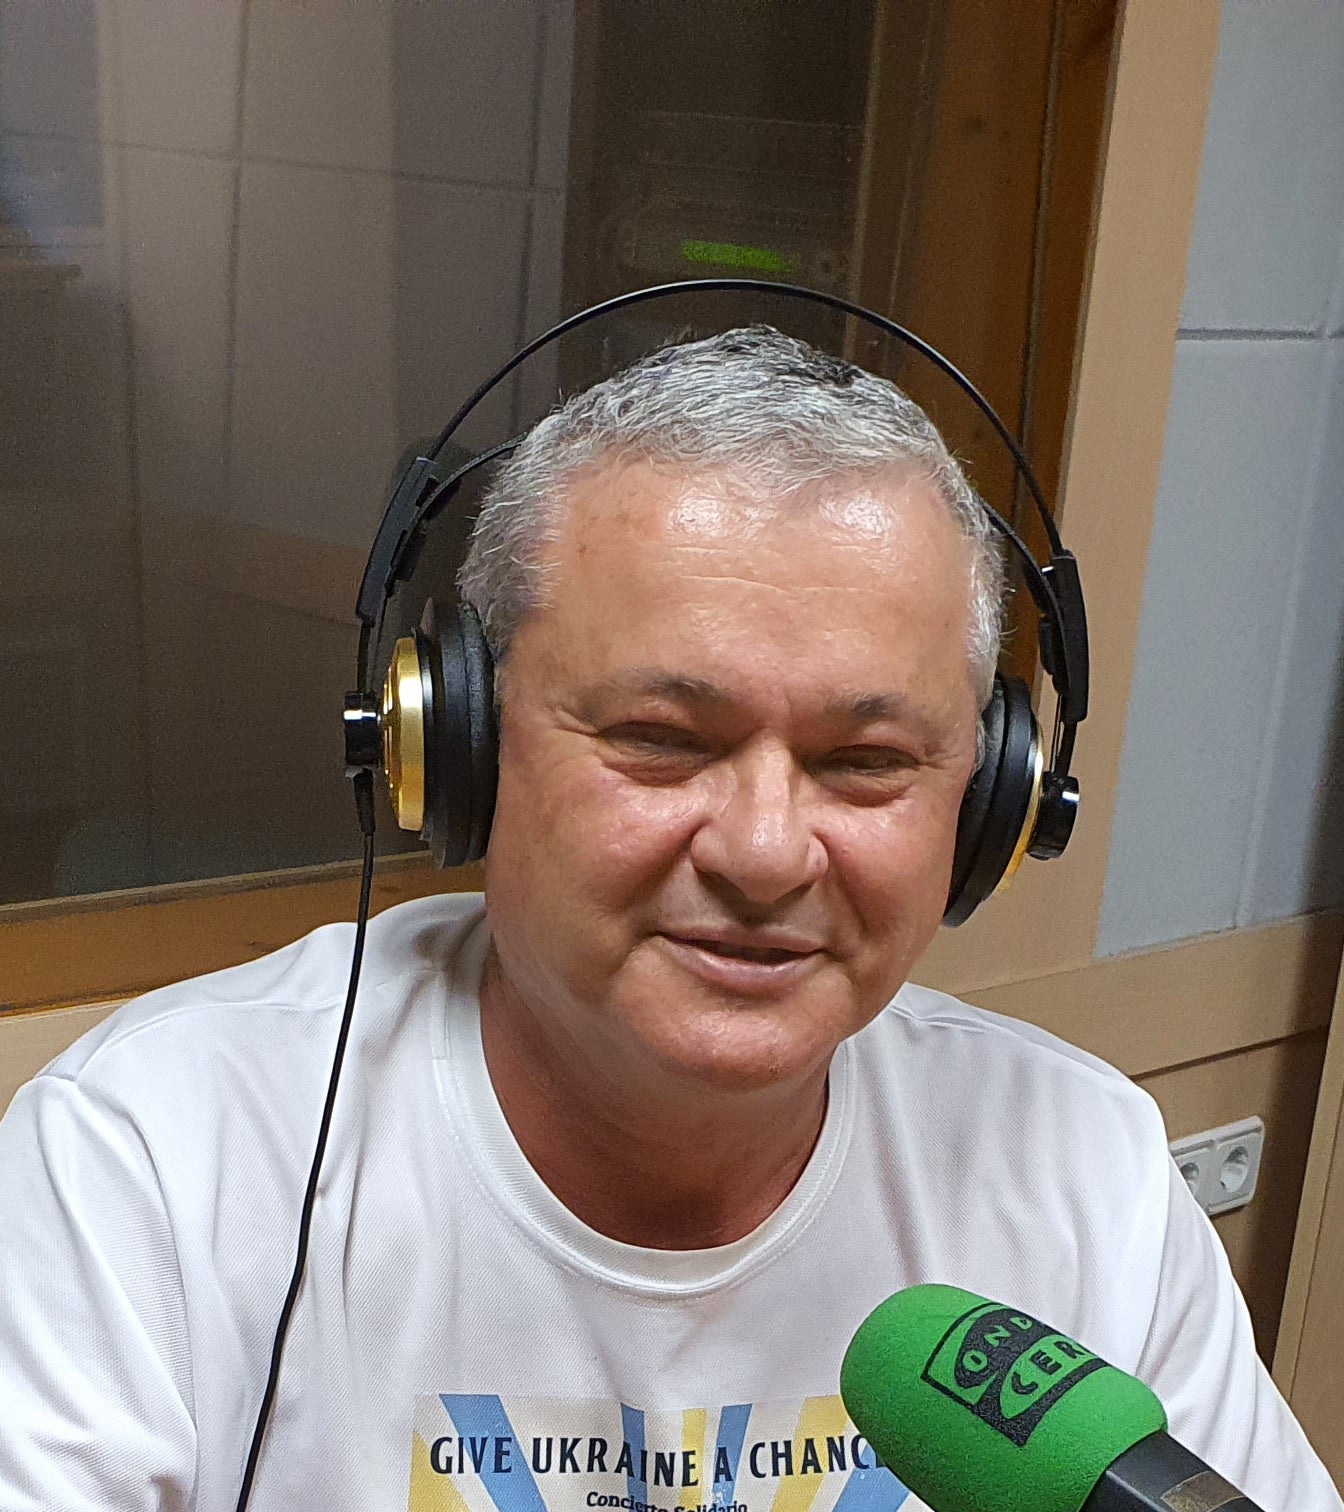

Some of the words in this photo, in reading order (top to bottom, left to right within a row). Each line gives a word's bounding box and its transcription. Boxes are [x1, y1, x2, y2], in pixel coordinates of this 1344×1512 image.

[962, 1316, 1033, 1372] OND
[1011, 1341, 1085, 1395] CER
[430, 1436, 513, 1474] GIVE
[531, 1436, 699, 1488] UKRAINE
[713, 1446, 734, 1484] A
[749, 1434, 886, 1479] CHANC
